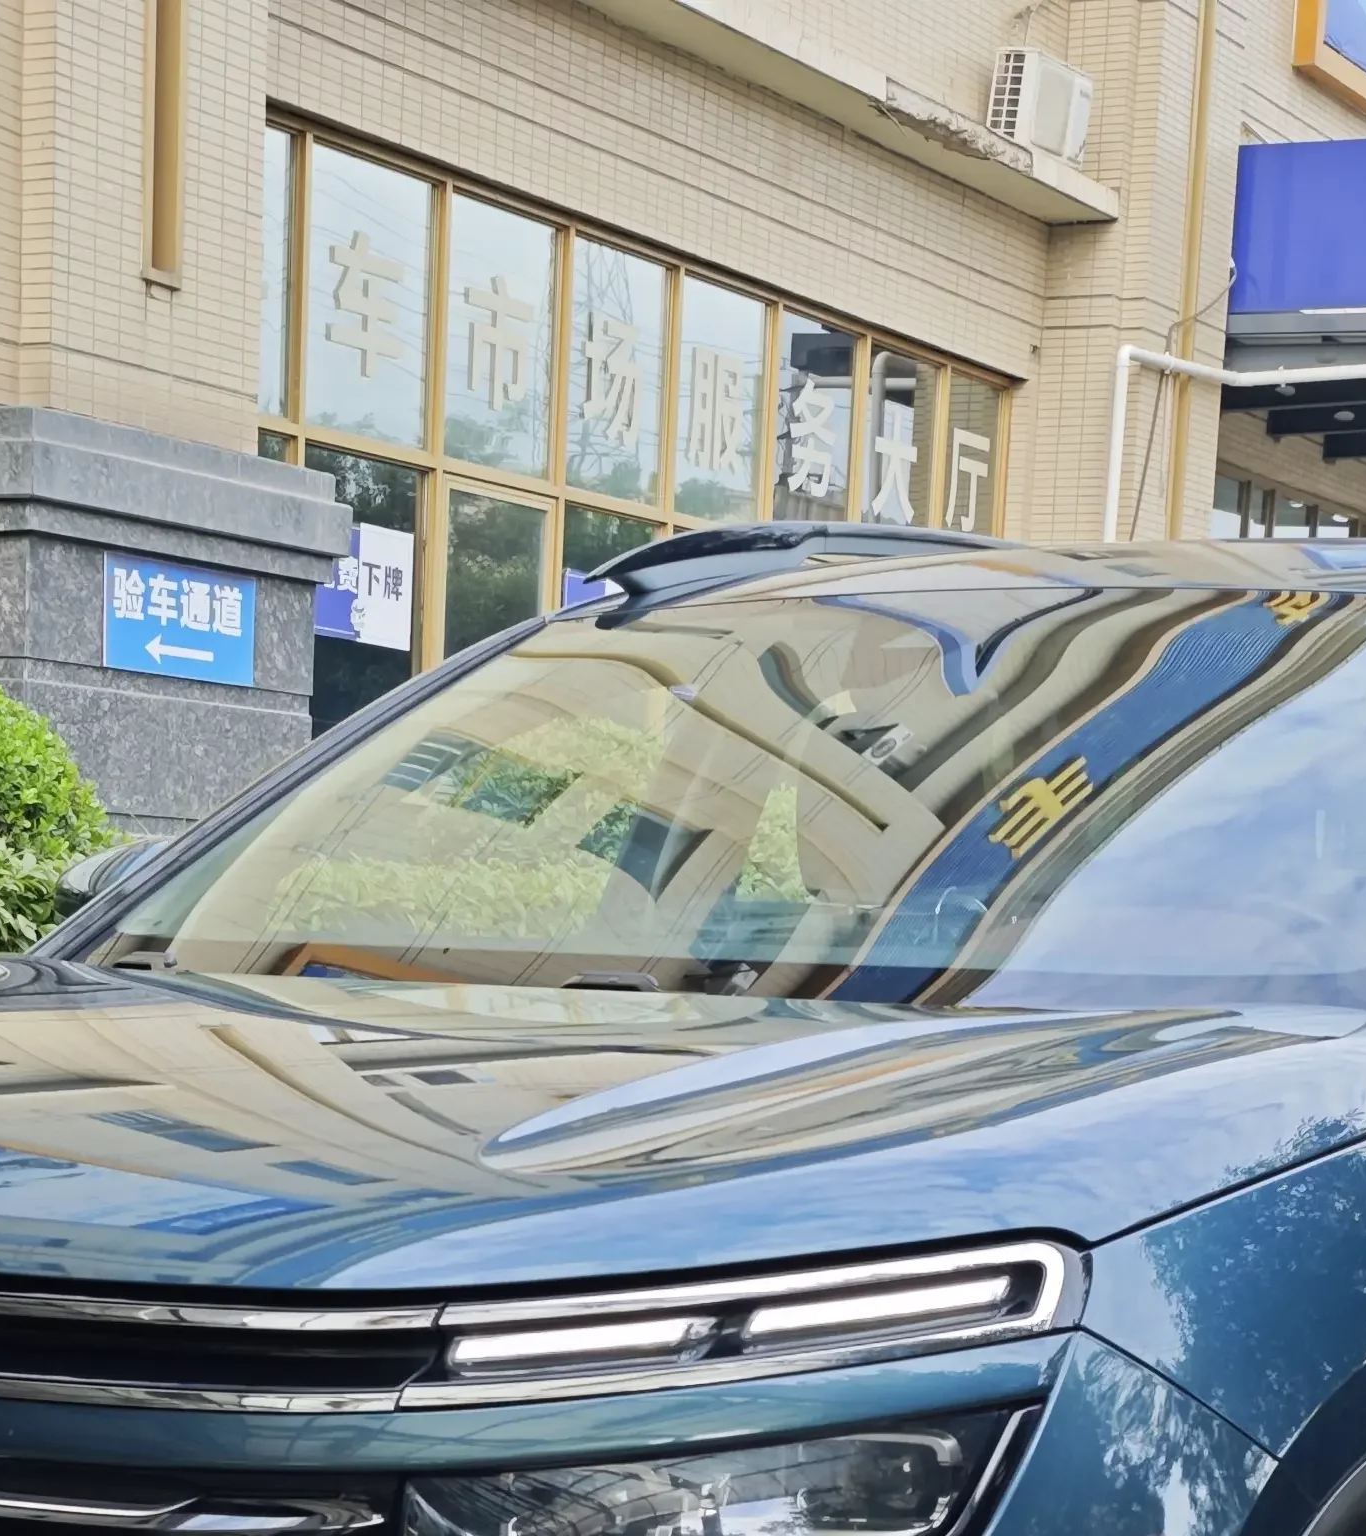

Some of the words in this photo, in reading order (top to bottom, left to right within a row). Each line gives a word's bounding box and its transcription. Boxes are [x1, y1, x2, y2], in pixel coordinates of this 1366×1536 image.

[325, 229, 992, 533] 车市场服务大厅
[112, 567, 243, 637] 验车通道
[323, 555, 403, 601] 费下牌
